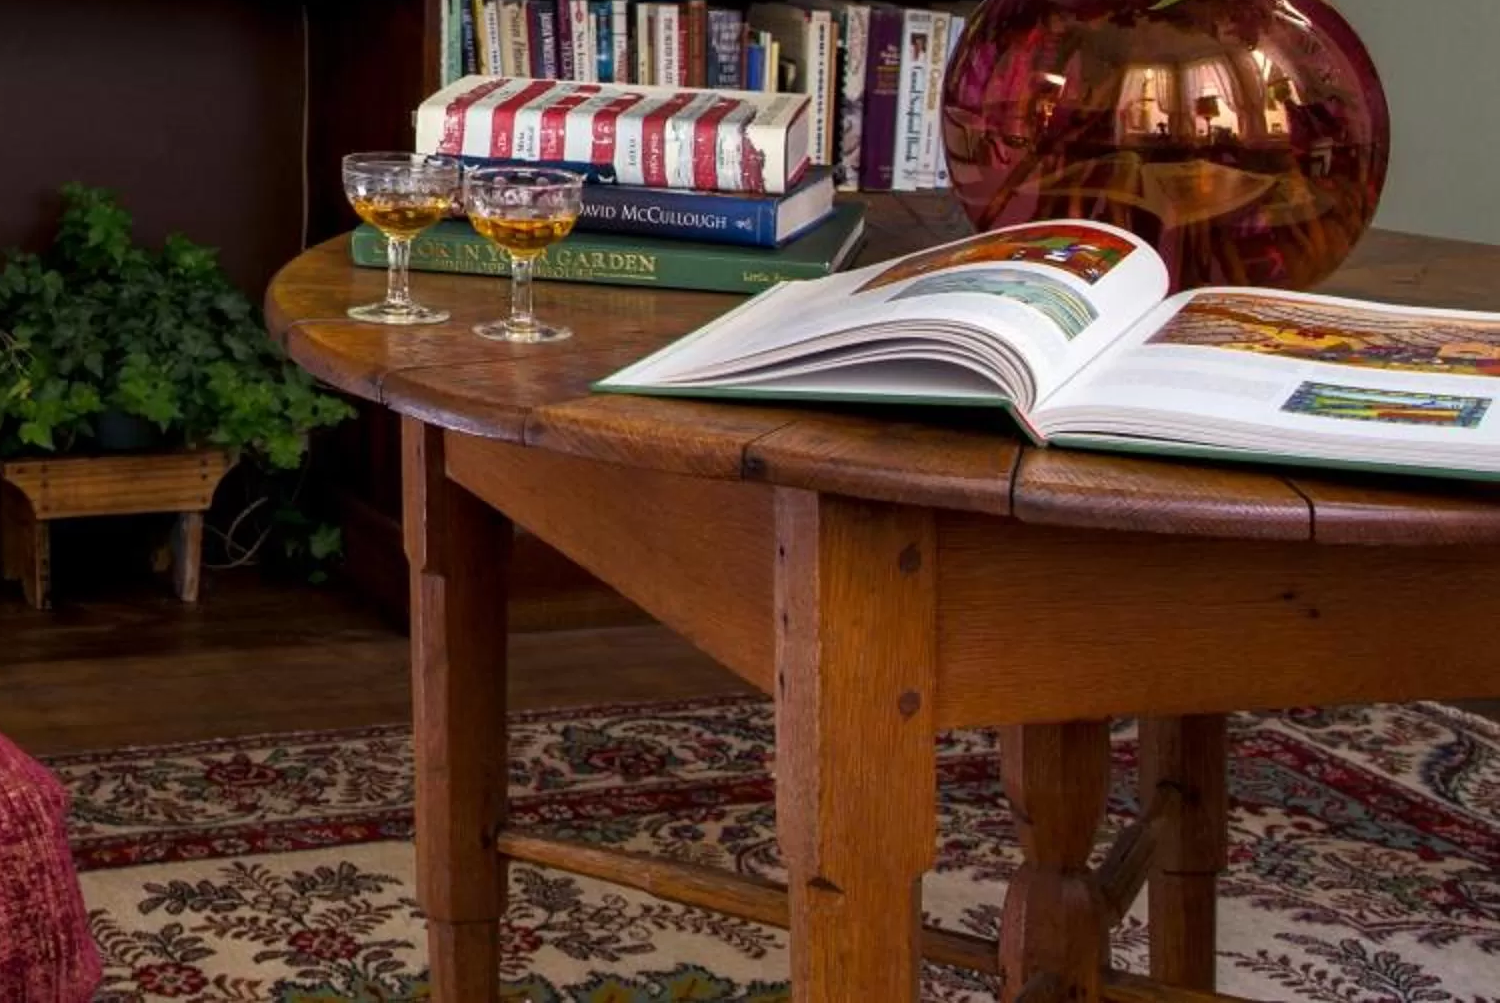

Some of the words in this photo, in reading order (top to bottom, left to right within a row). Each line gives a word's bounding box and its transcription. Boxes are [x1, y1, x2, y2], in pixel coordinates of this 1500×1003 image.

[577, 201, 616, 220] DAVID
[456, 243, 484, 261] IN
[556, 248, 657, 273] GARDEN
